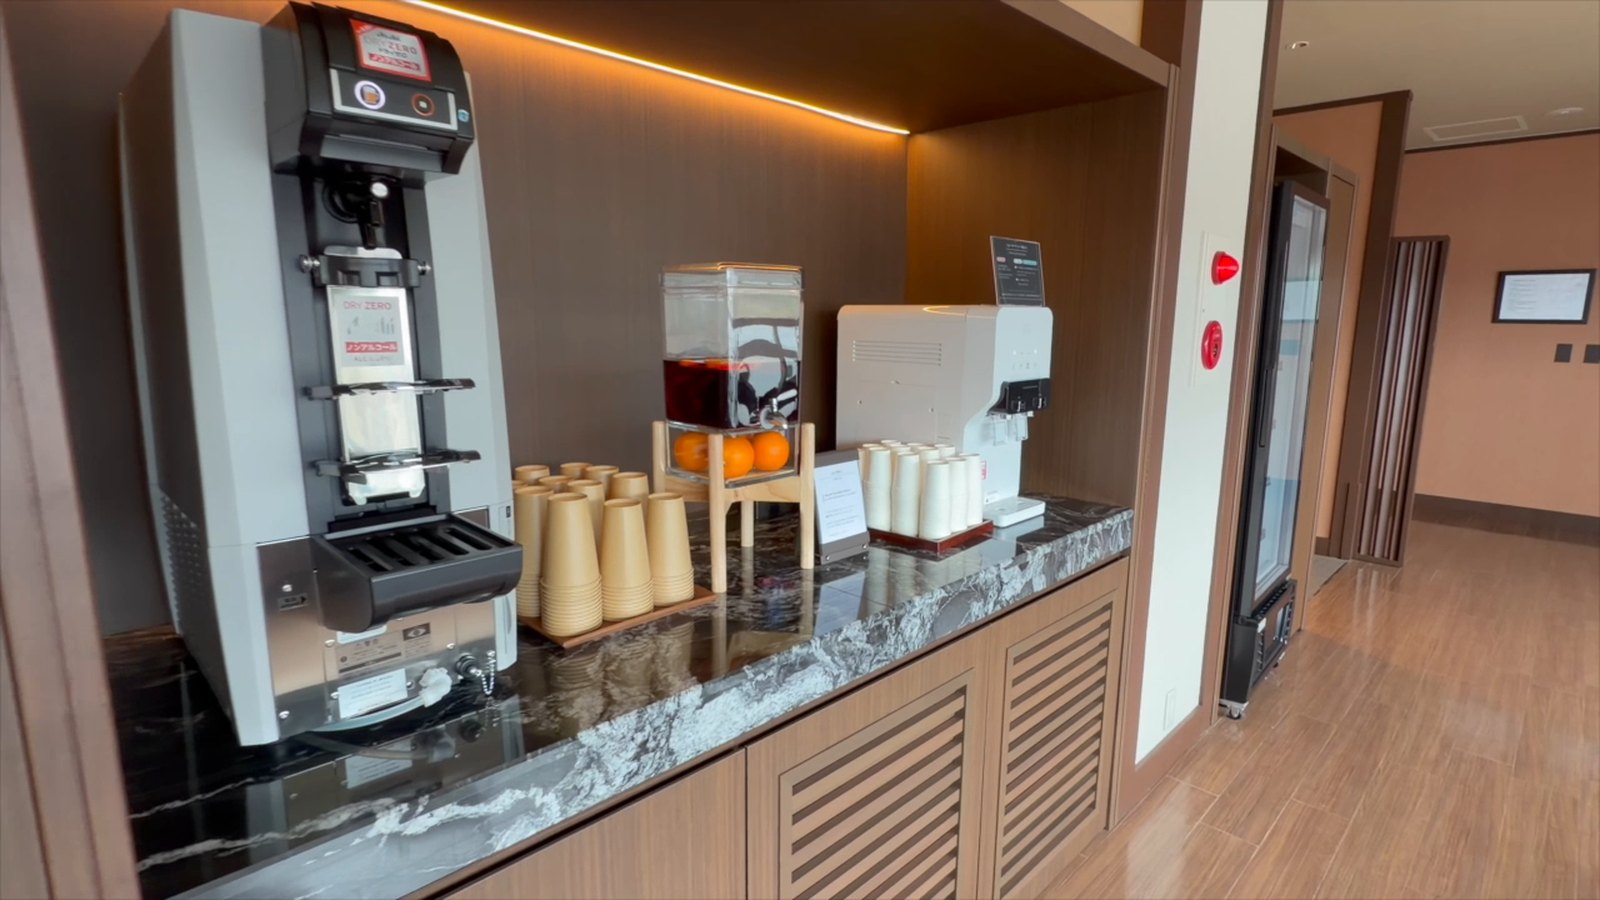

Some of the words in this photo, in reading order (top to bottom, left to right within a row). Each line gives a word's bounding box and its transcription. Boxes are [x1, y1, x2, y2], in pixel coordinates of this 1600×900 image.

[388, 42, 418, 55] ZERO
[364, 301, 392, 310] ZERO
[347, 343, 396, 352] ノンアルコール
